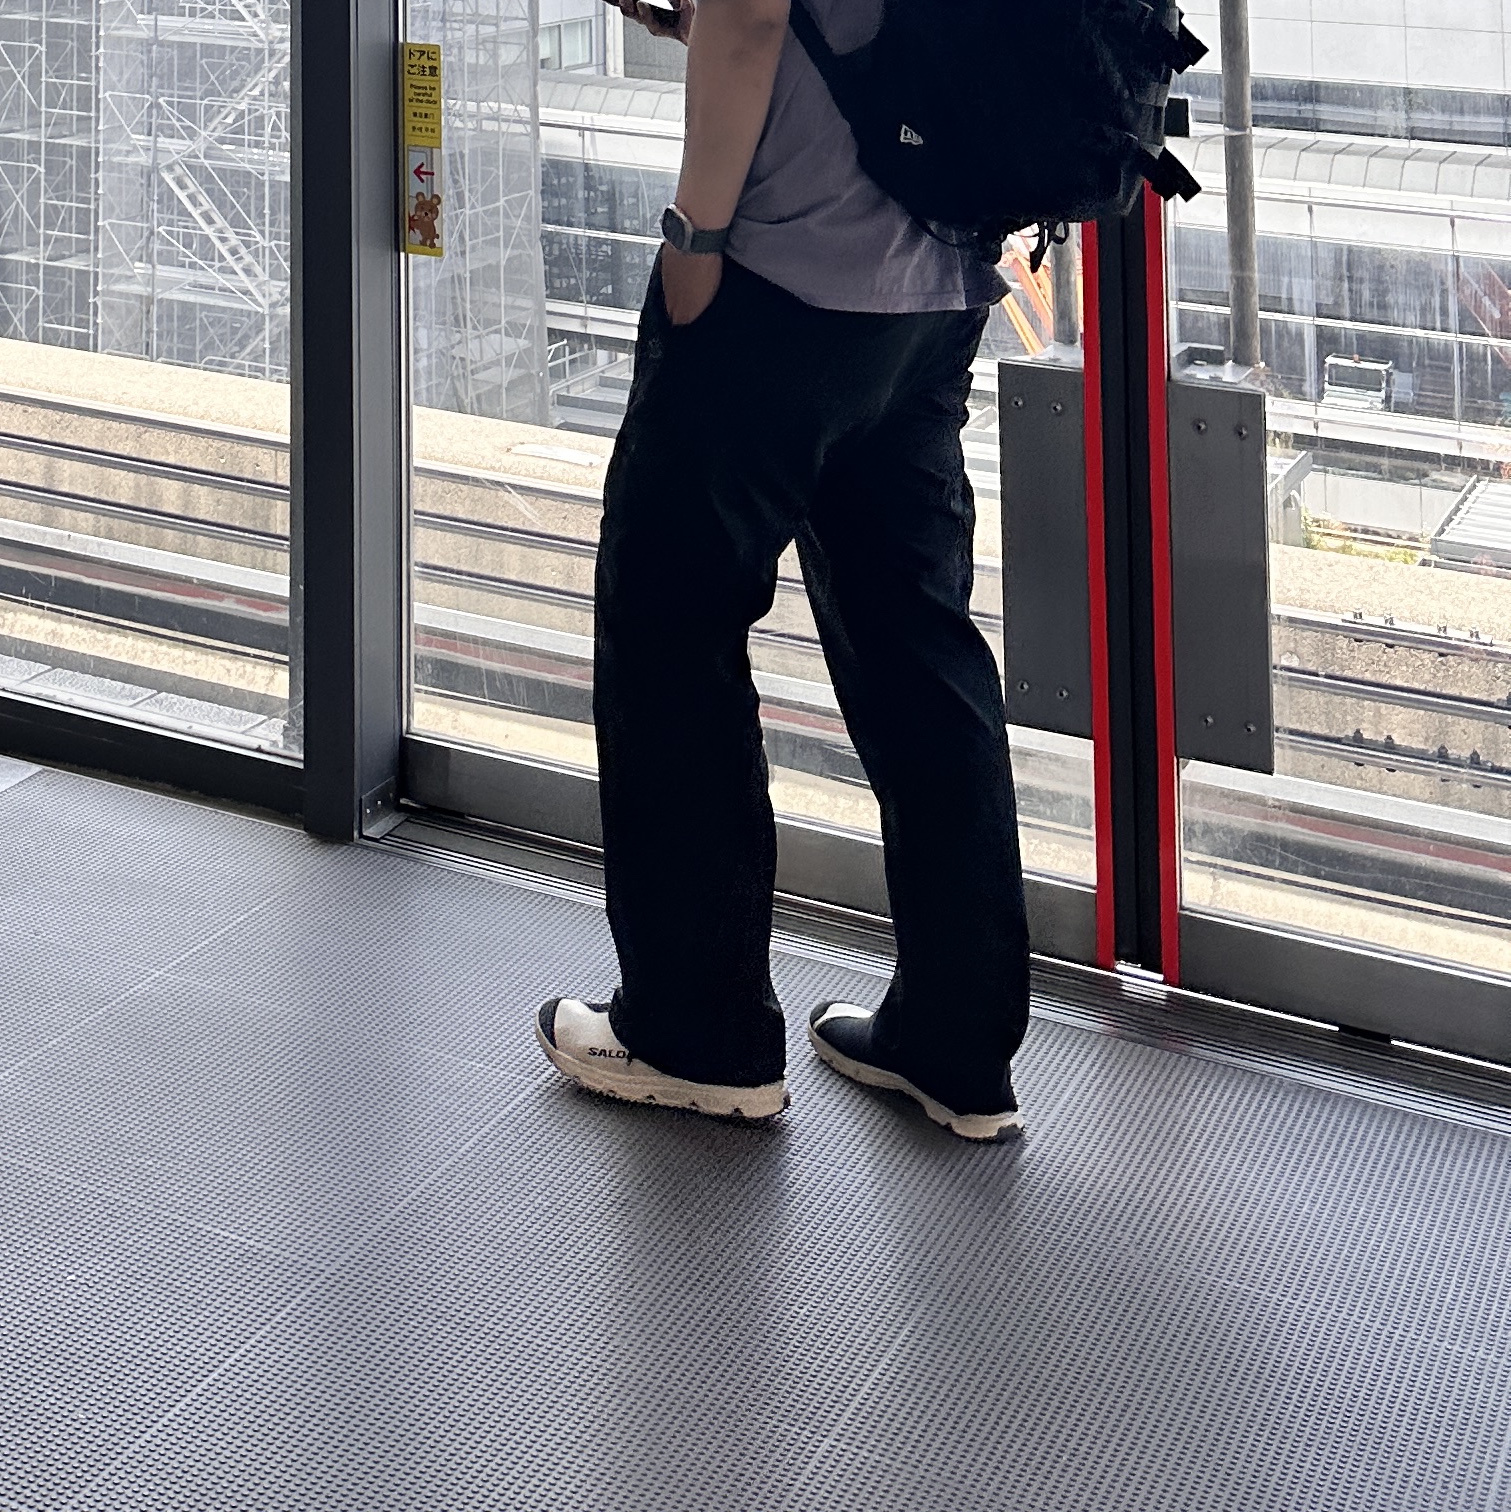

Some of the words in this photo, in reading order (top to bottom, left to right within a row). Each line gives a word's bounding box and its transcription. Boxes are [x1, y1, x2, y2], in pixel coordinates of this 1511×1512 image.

[407, 63, 439, 77] ご注意
[587, 1047, 627, 1059] SALO
